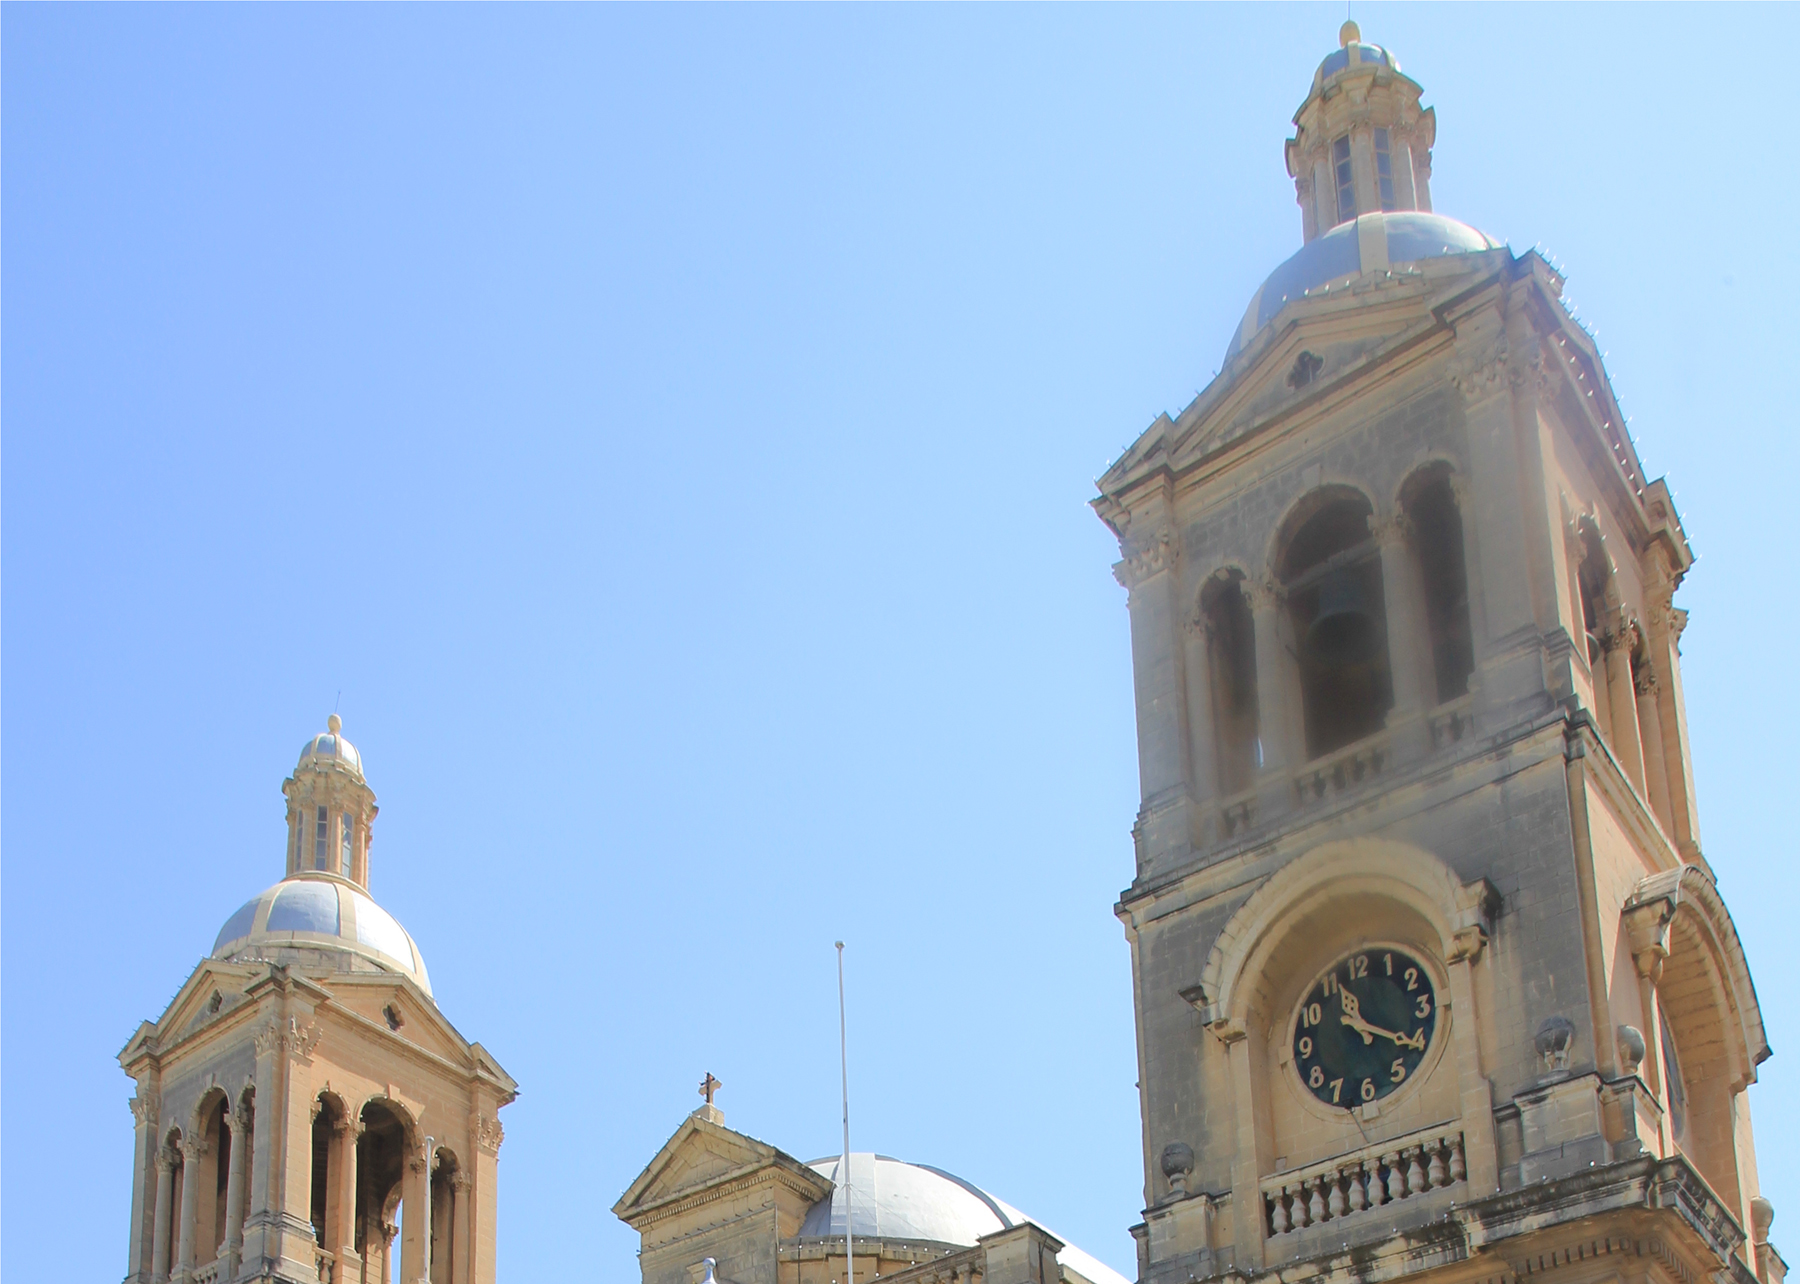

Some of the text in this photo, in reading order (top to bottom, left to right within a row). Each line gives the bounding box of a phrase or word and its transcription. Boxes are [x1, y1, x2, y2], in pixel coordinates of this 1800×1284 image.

[1348, 955, 1369, 980] 12
[1383, 953, 1393, 976] 1
[1321, 973, 1338, 997] 11
[1404, 967, 1419, 991] 2
[1302, 1003, 1322, 1028] 10
[1415, 994, 1431, 1019] 3
[1299, 1036, 1313, 1059] 9
[1408, 1027, 1425, 1051] 4
[1309, 1065, 1324, 1089] 8
[1390, 1057, 1406, 1083] 5
[1329, 1078, 1344, 1104] 7
[1360, 1078, 1375, 1101] 6
